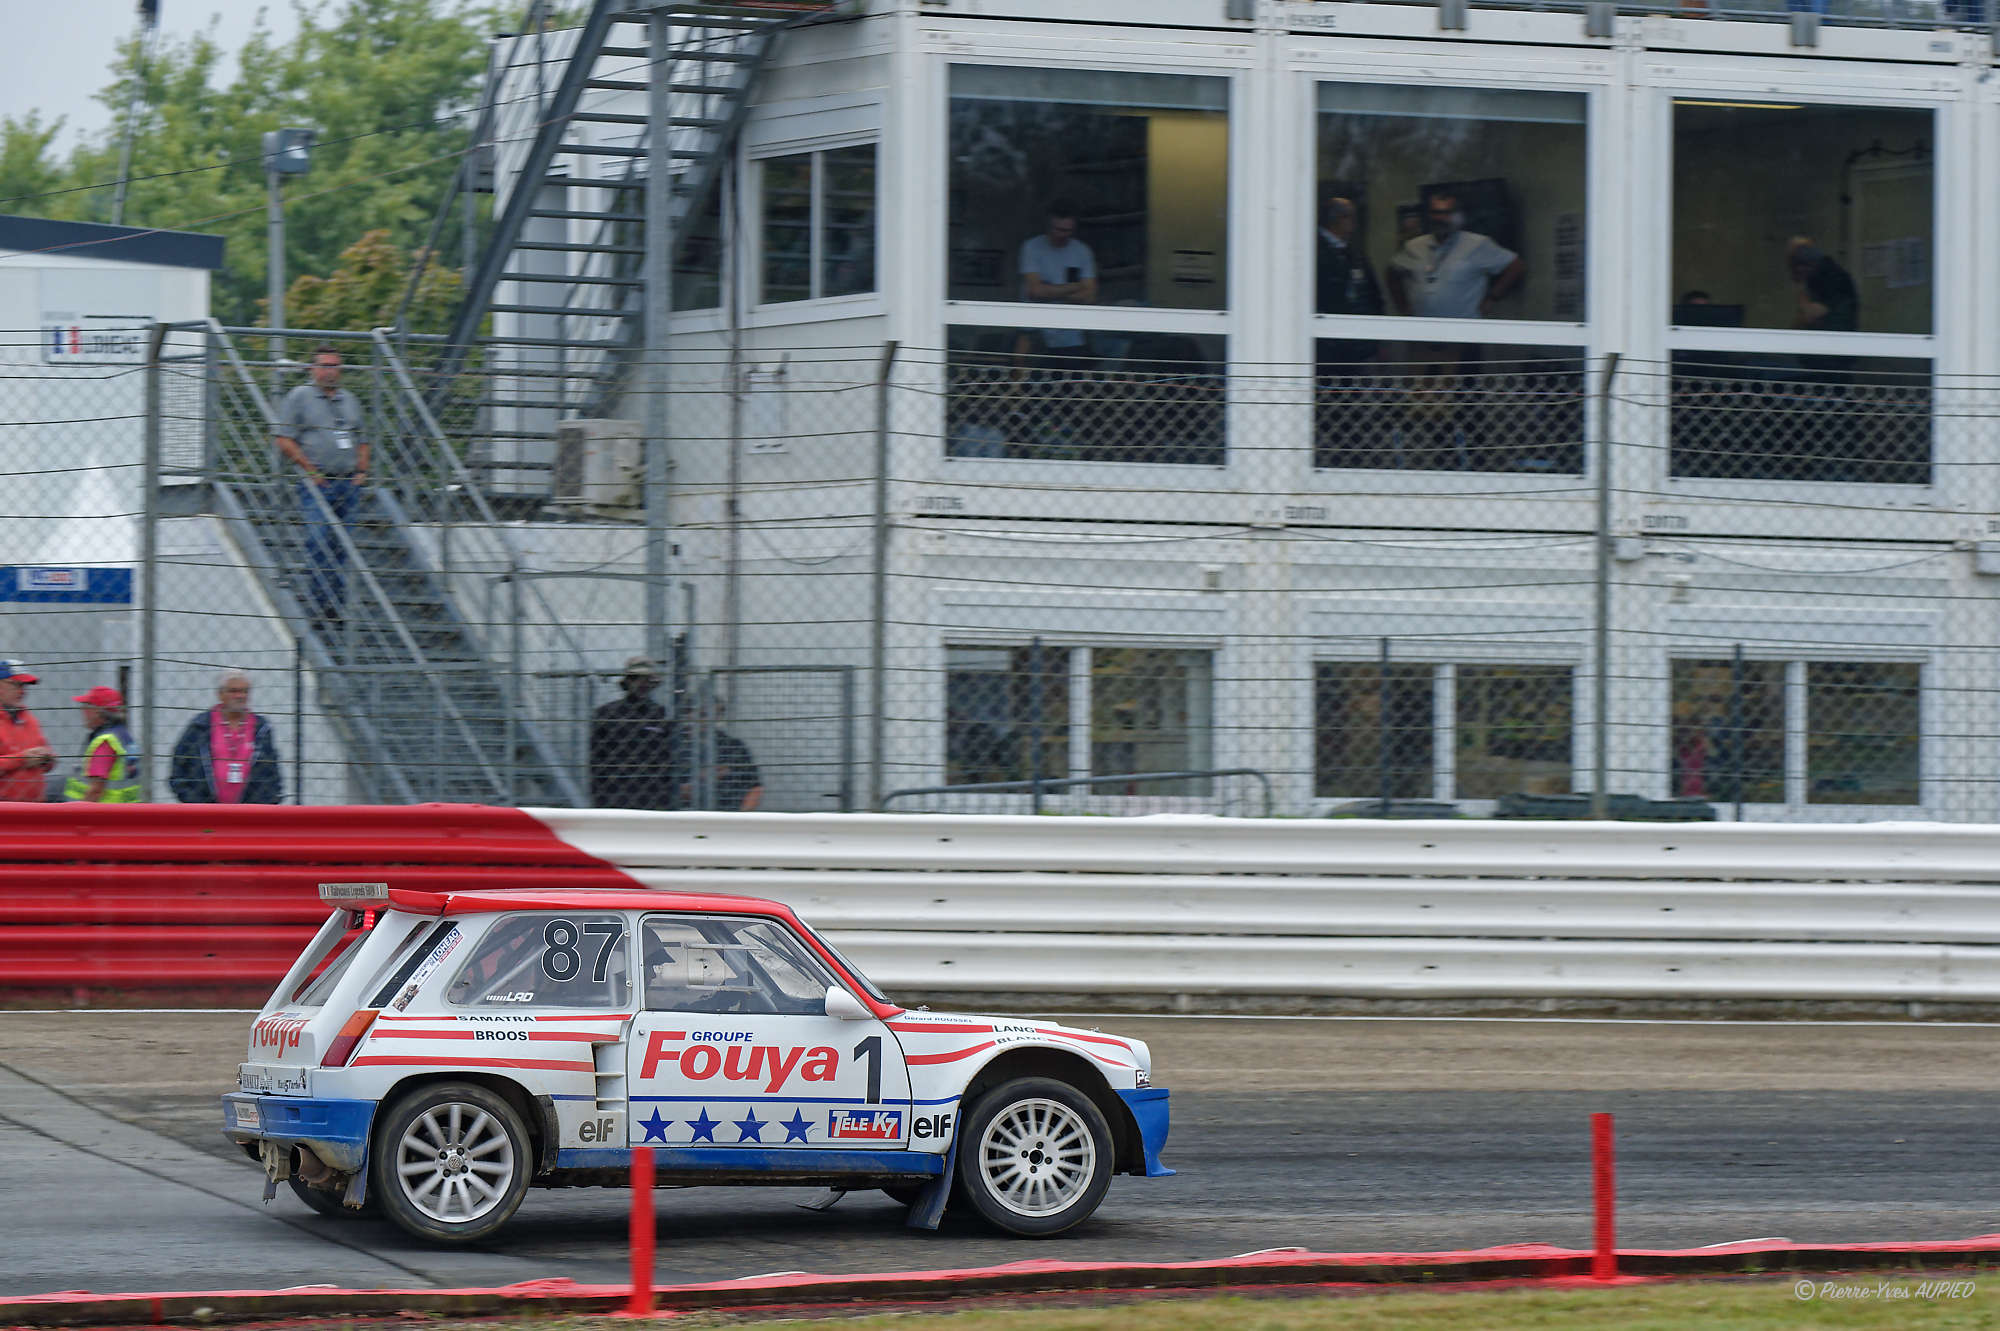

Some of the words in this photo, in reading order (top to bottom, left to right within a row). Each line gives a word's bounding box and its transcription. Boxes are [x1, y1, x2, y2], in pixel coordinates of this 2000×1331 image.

[432, 929, 460, 960] LOHEAC
[541, 919, 623, 982] 87
[475, 1031, 529, 1041] BROOS
[691, 1031, 753, 1042] GROUPE
[994, 1024, 1035, 1033] LANG
[997, 1036, 1049, 1045] BLANC
[640, 1031, 839, 1093] Fouya
[853, 1036, 882, 1104] 1
[579, 1118, 614, 1142] elf
[872, 1112, 898, 1137] K7
[913, 1114, 951, 1138] elf
